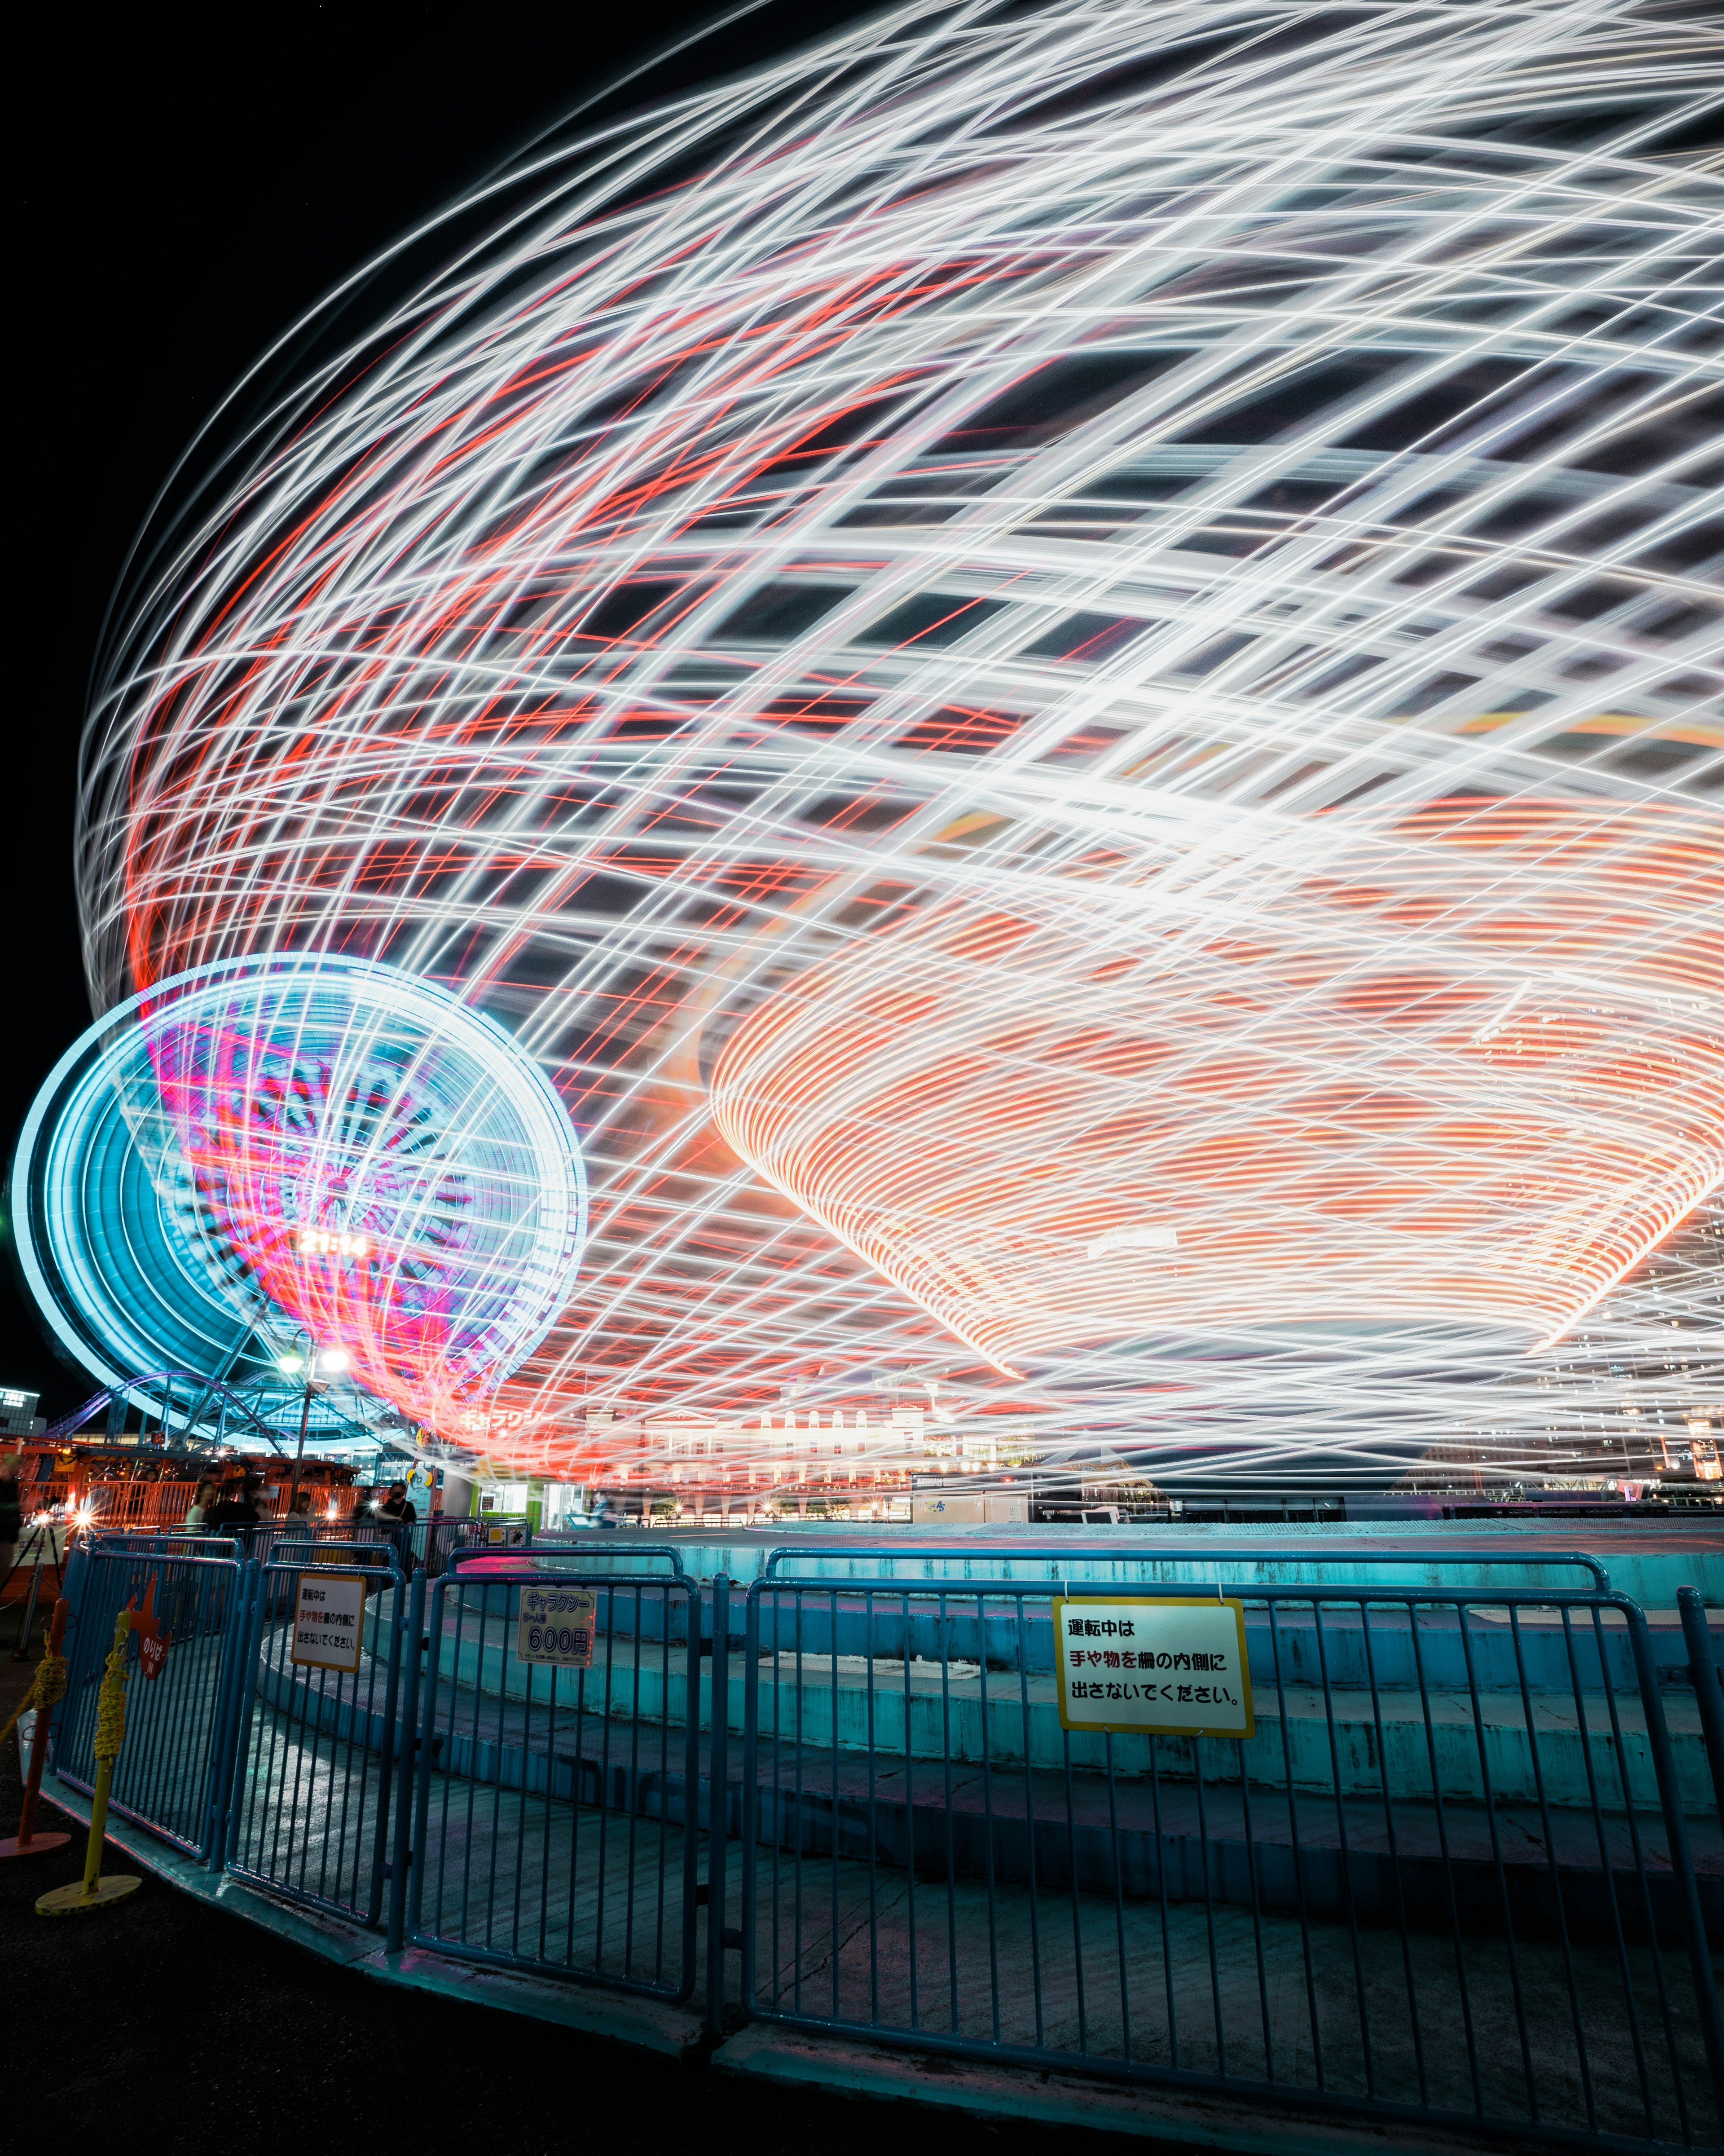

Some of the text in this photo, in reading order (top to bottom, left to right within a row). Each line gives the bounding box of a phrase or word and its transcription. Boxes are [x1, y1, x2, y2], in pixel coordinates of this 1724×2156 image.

[300, 1231, 366, 1257] 21:14
[917, 1478, 942, 1486] AIRMAN
[18, 1540, 46, 1548] 立禁
[301, 1588, 326, 1601] 運転中は
[528, 1592, 589, 1612] ギャラクシー
[300, 1610, 355, 1627] 手や物を柵の内側に
[1068, 1619, 1135, 1637] 運転中は
[143, 1637, 163, 1661] のりば
[297, 1631, 355, 1651] 出さないでください。
[528, 1626, 589, 1655] 600円
[147, 1661, 154, 1674] IN
[1069, 1650, 1227, 1671] 手や物を柵の内側に
[1072, 1681, 1238, 1706] 出さないでください。
